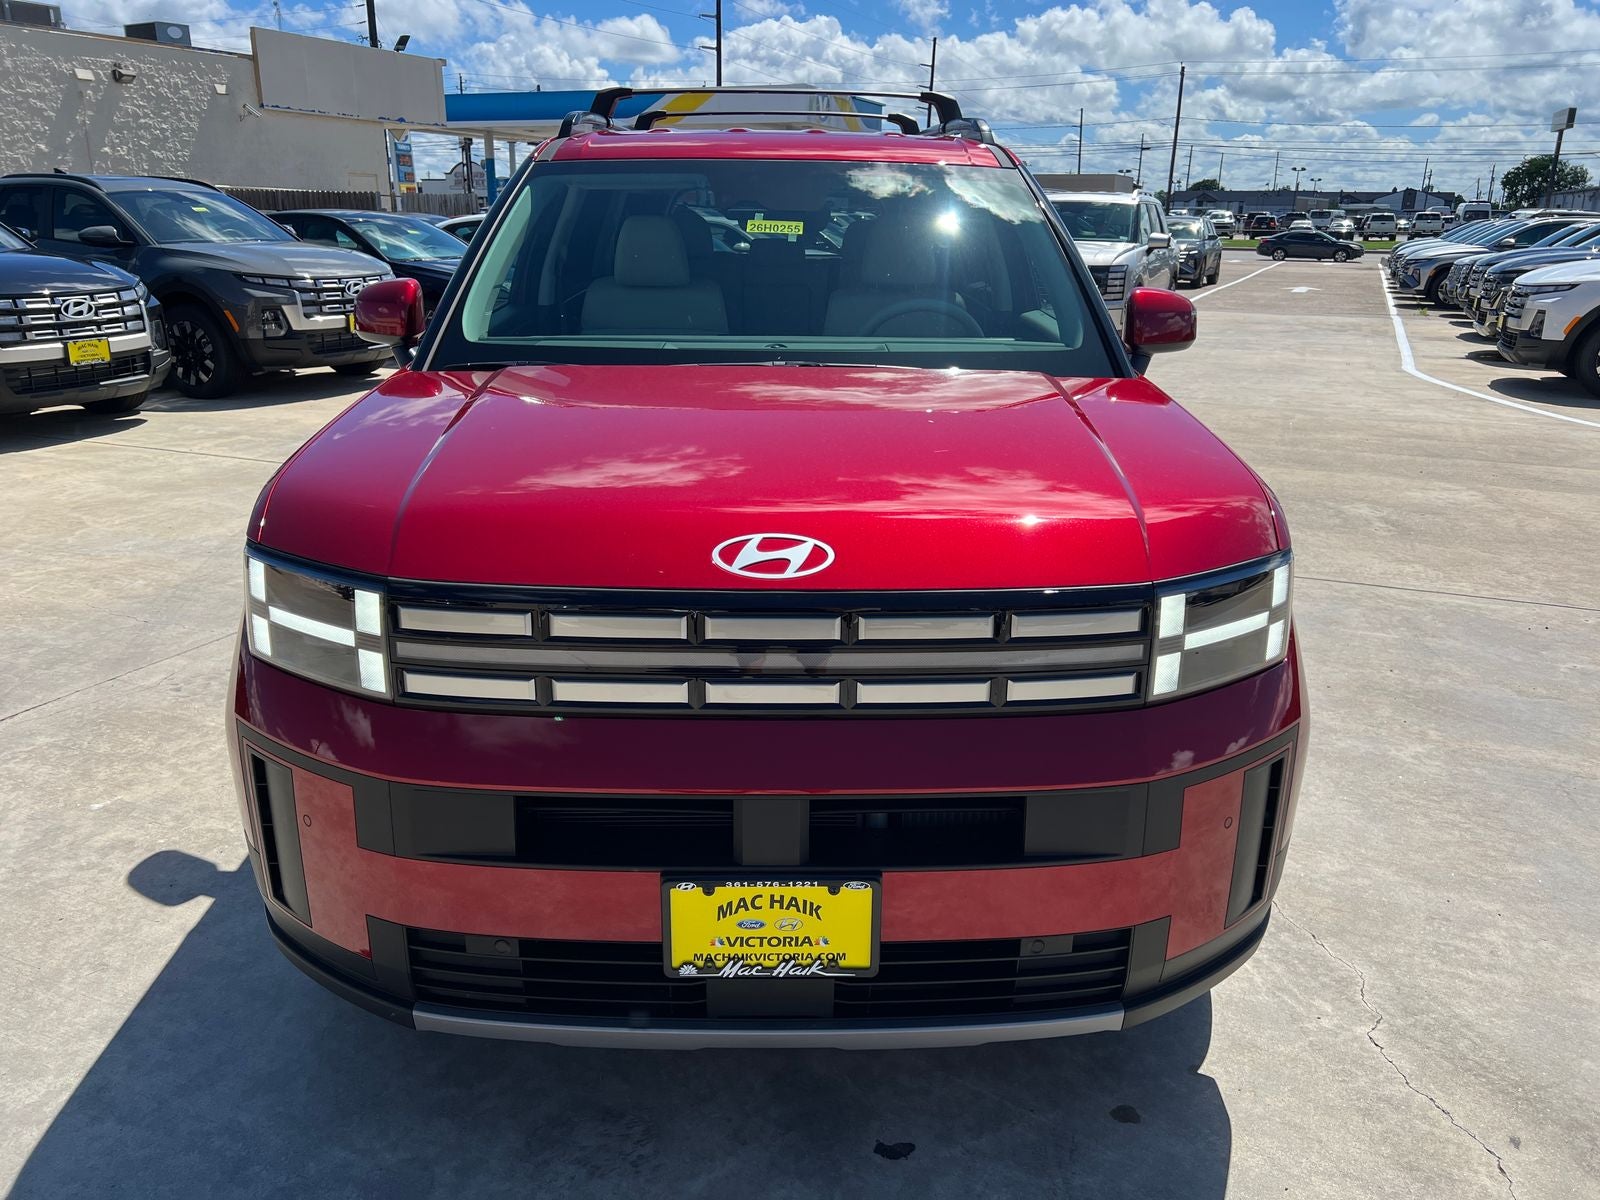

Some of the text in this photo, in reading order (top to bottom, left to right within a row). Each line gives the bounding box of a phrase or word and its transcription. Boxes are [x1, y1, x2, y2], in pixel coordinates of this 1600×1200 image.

[749, 223, 801, 233] 26H0255
[717, 894, 822, 921] MAC HAIK
[725, 936, 814, 947] VICTORIA
[693, 952, 847, 962] MACHAIKVICTORIA.COM
[718, 960, 827, 977] Mac Haik
